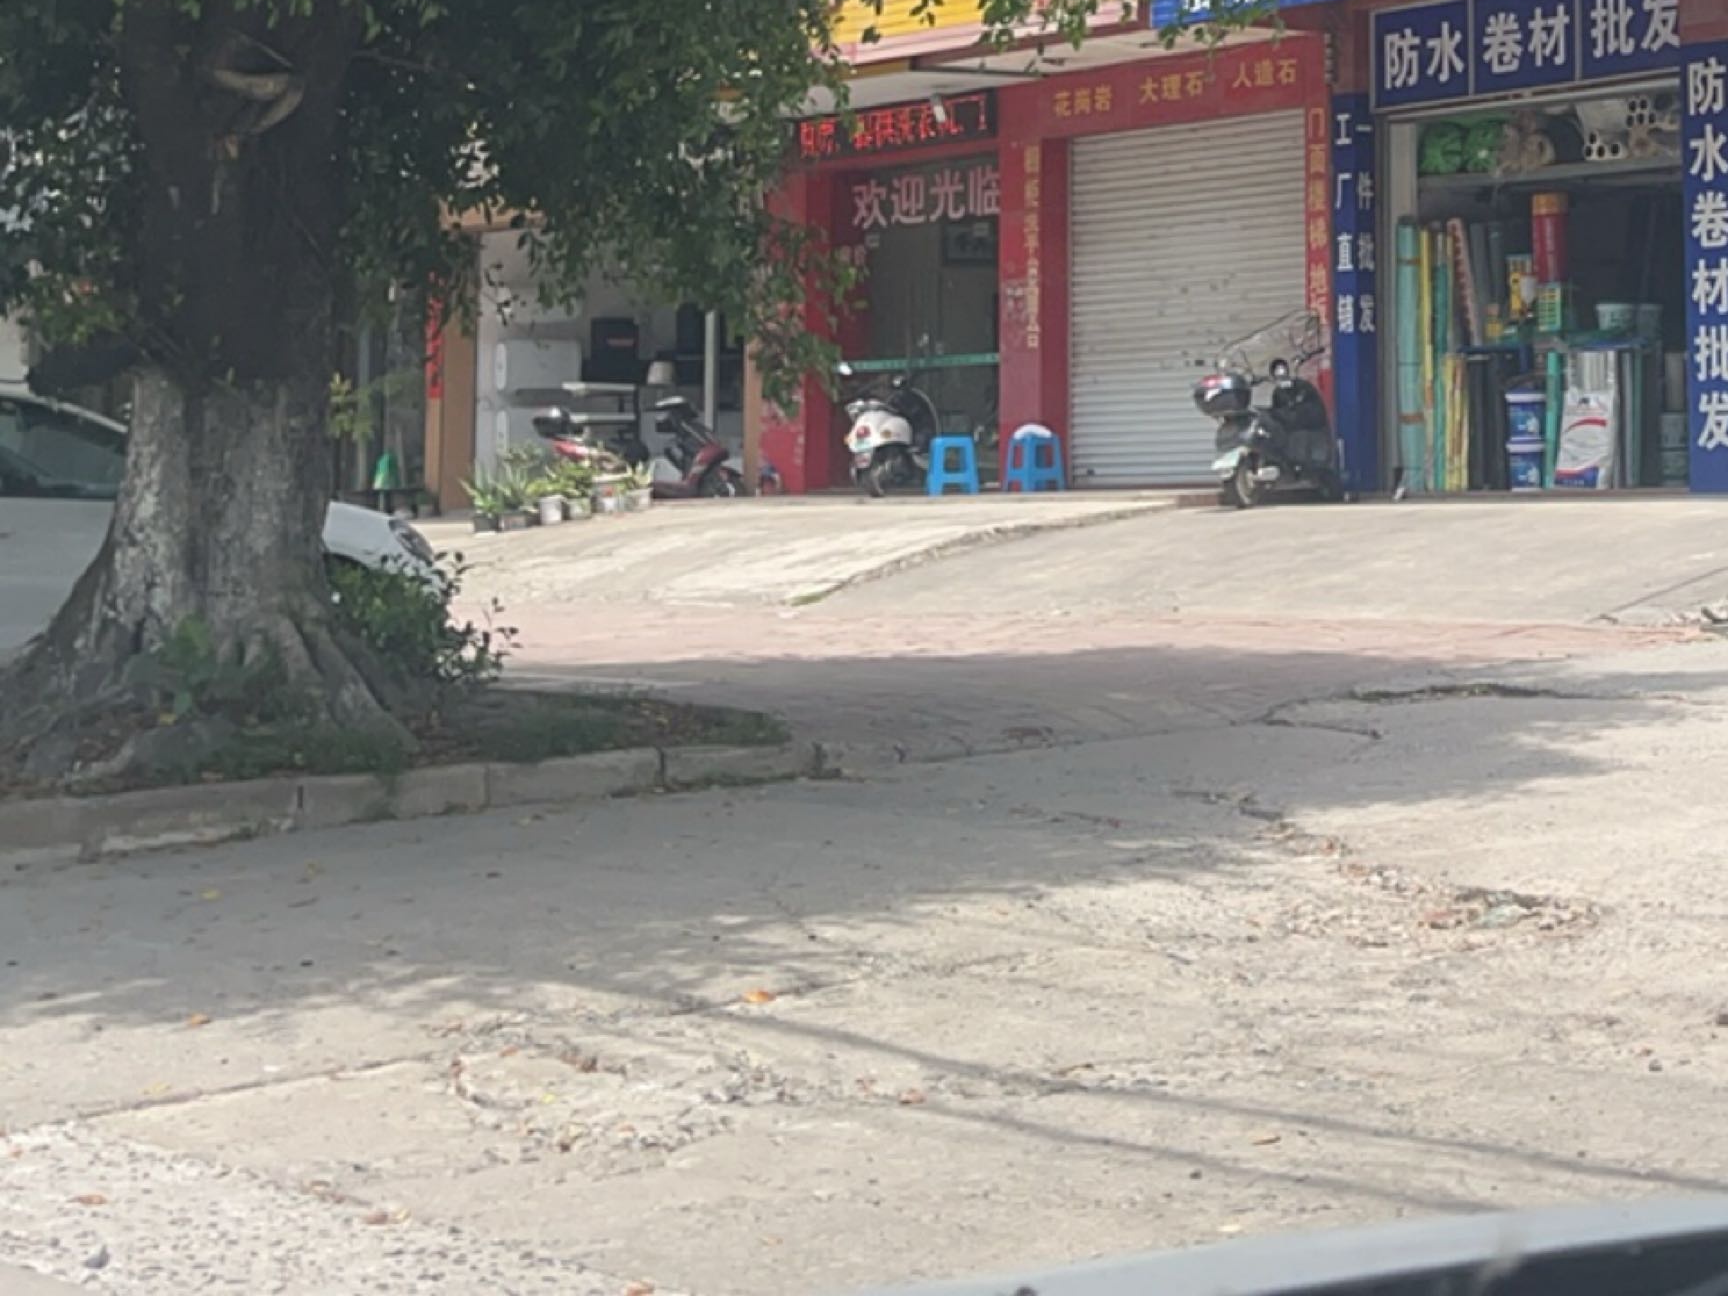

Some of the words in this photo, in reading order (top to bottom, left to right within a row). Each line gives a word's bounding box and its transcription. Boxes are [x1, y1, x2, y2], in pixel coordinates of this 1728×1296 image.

[1384, 22, 1465, 89] 防水
[1483, 7, 1570, 73] 卷材
[1139, 70, 1205, 103] 大理石
[1232, 58, 1297, 89] 人造石
[852, 167, 1000, 229] 欢迎光临
